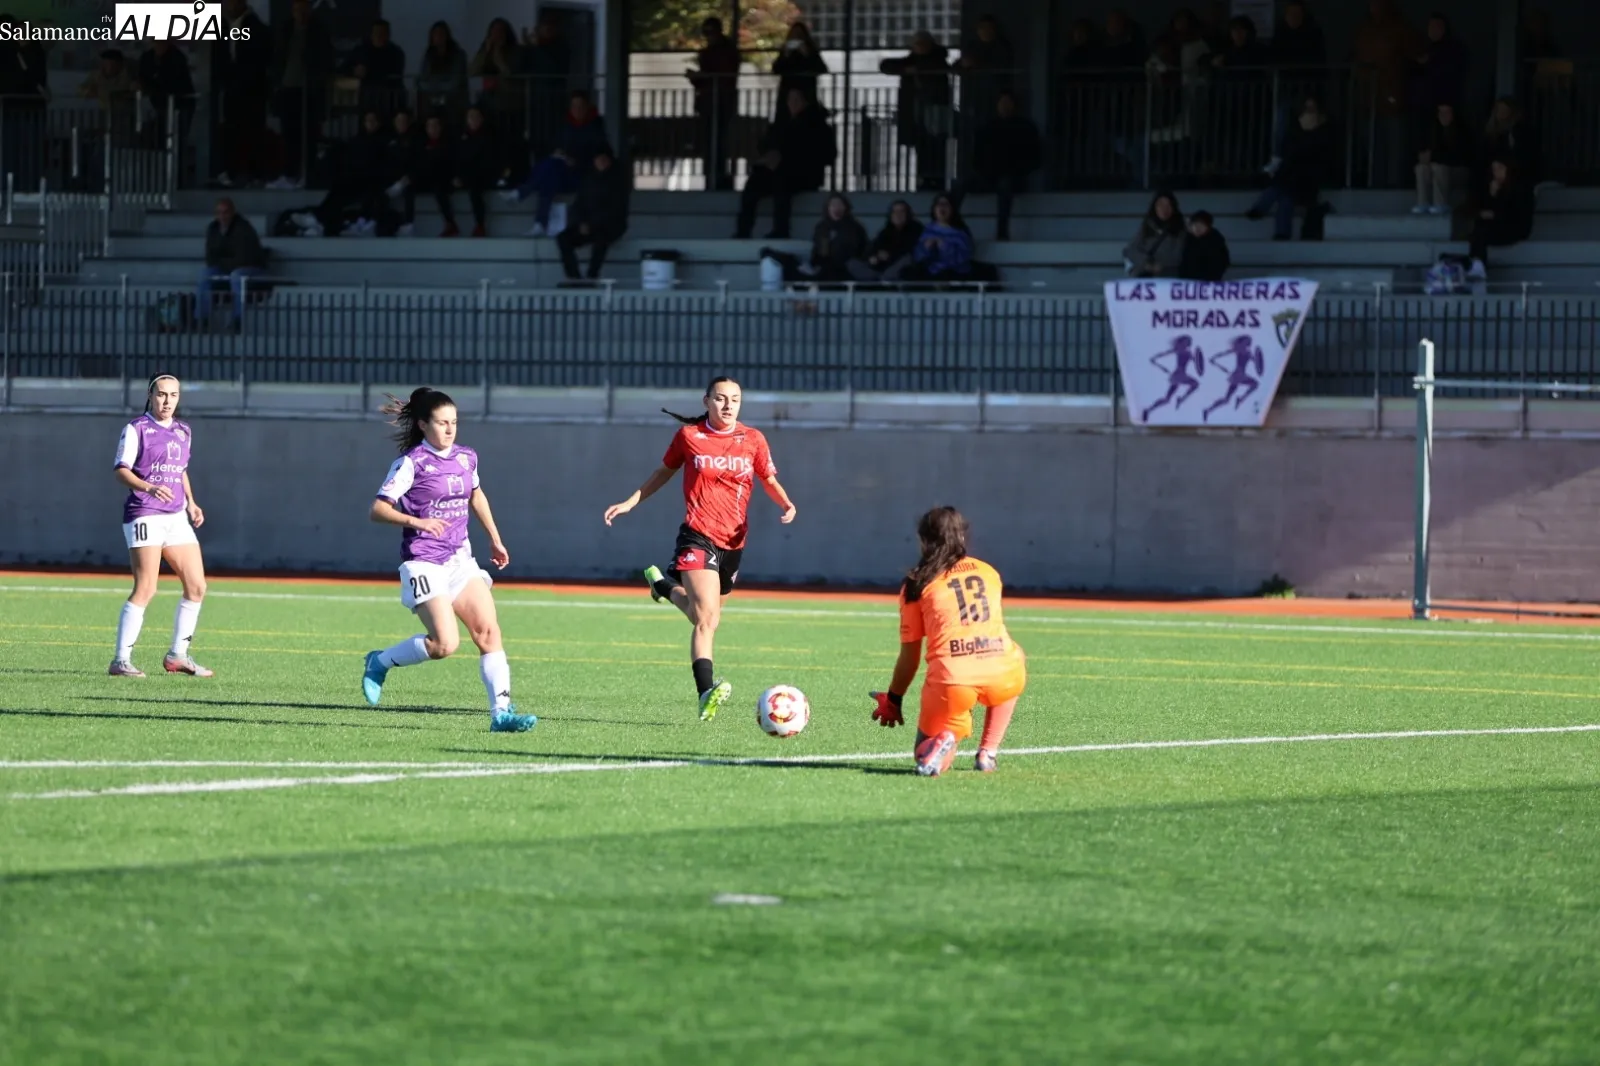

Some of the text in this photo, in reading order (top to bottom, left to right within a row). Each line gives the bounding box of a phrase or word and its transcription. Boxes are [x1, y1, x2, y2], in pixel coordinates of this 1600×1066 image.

[1115, 281, 1300, 301] LAS GUERRERAS
[1151, 309, 1260, 329] MORADAS
[694, 454, 752, 472] meins
[134, 522, 148, 542] 10
[410, 574, 431, 600] 20
[947, 575, 990, 623] 13
